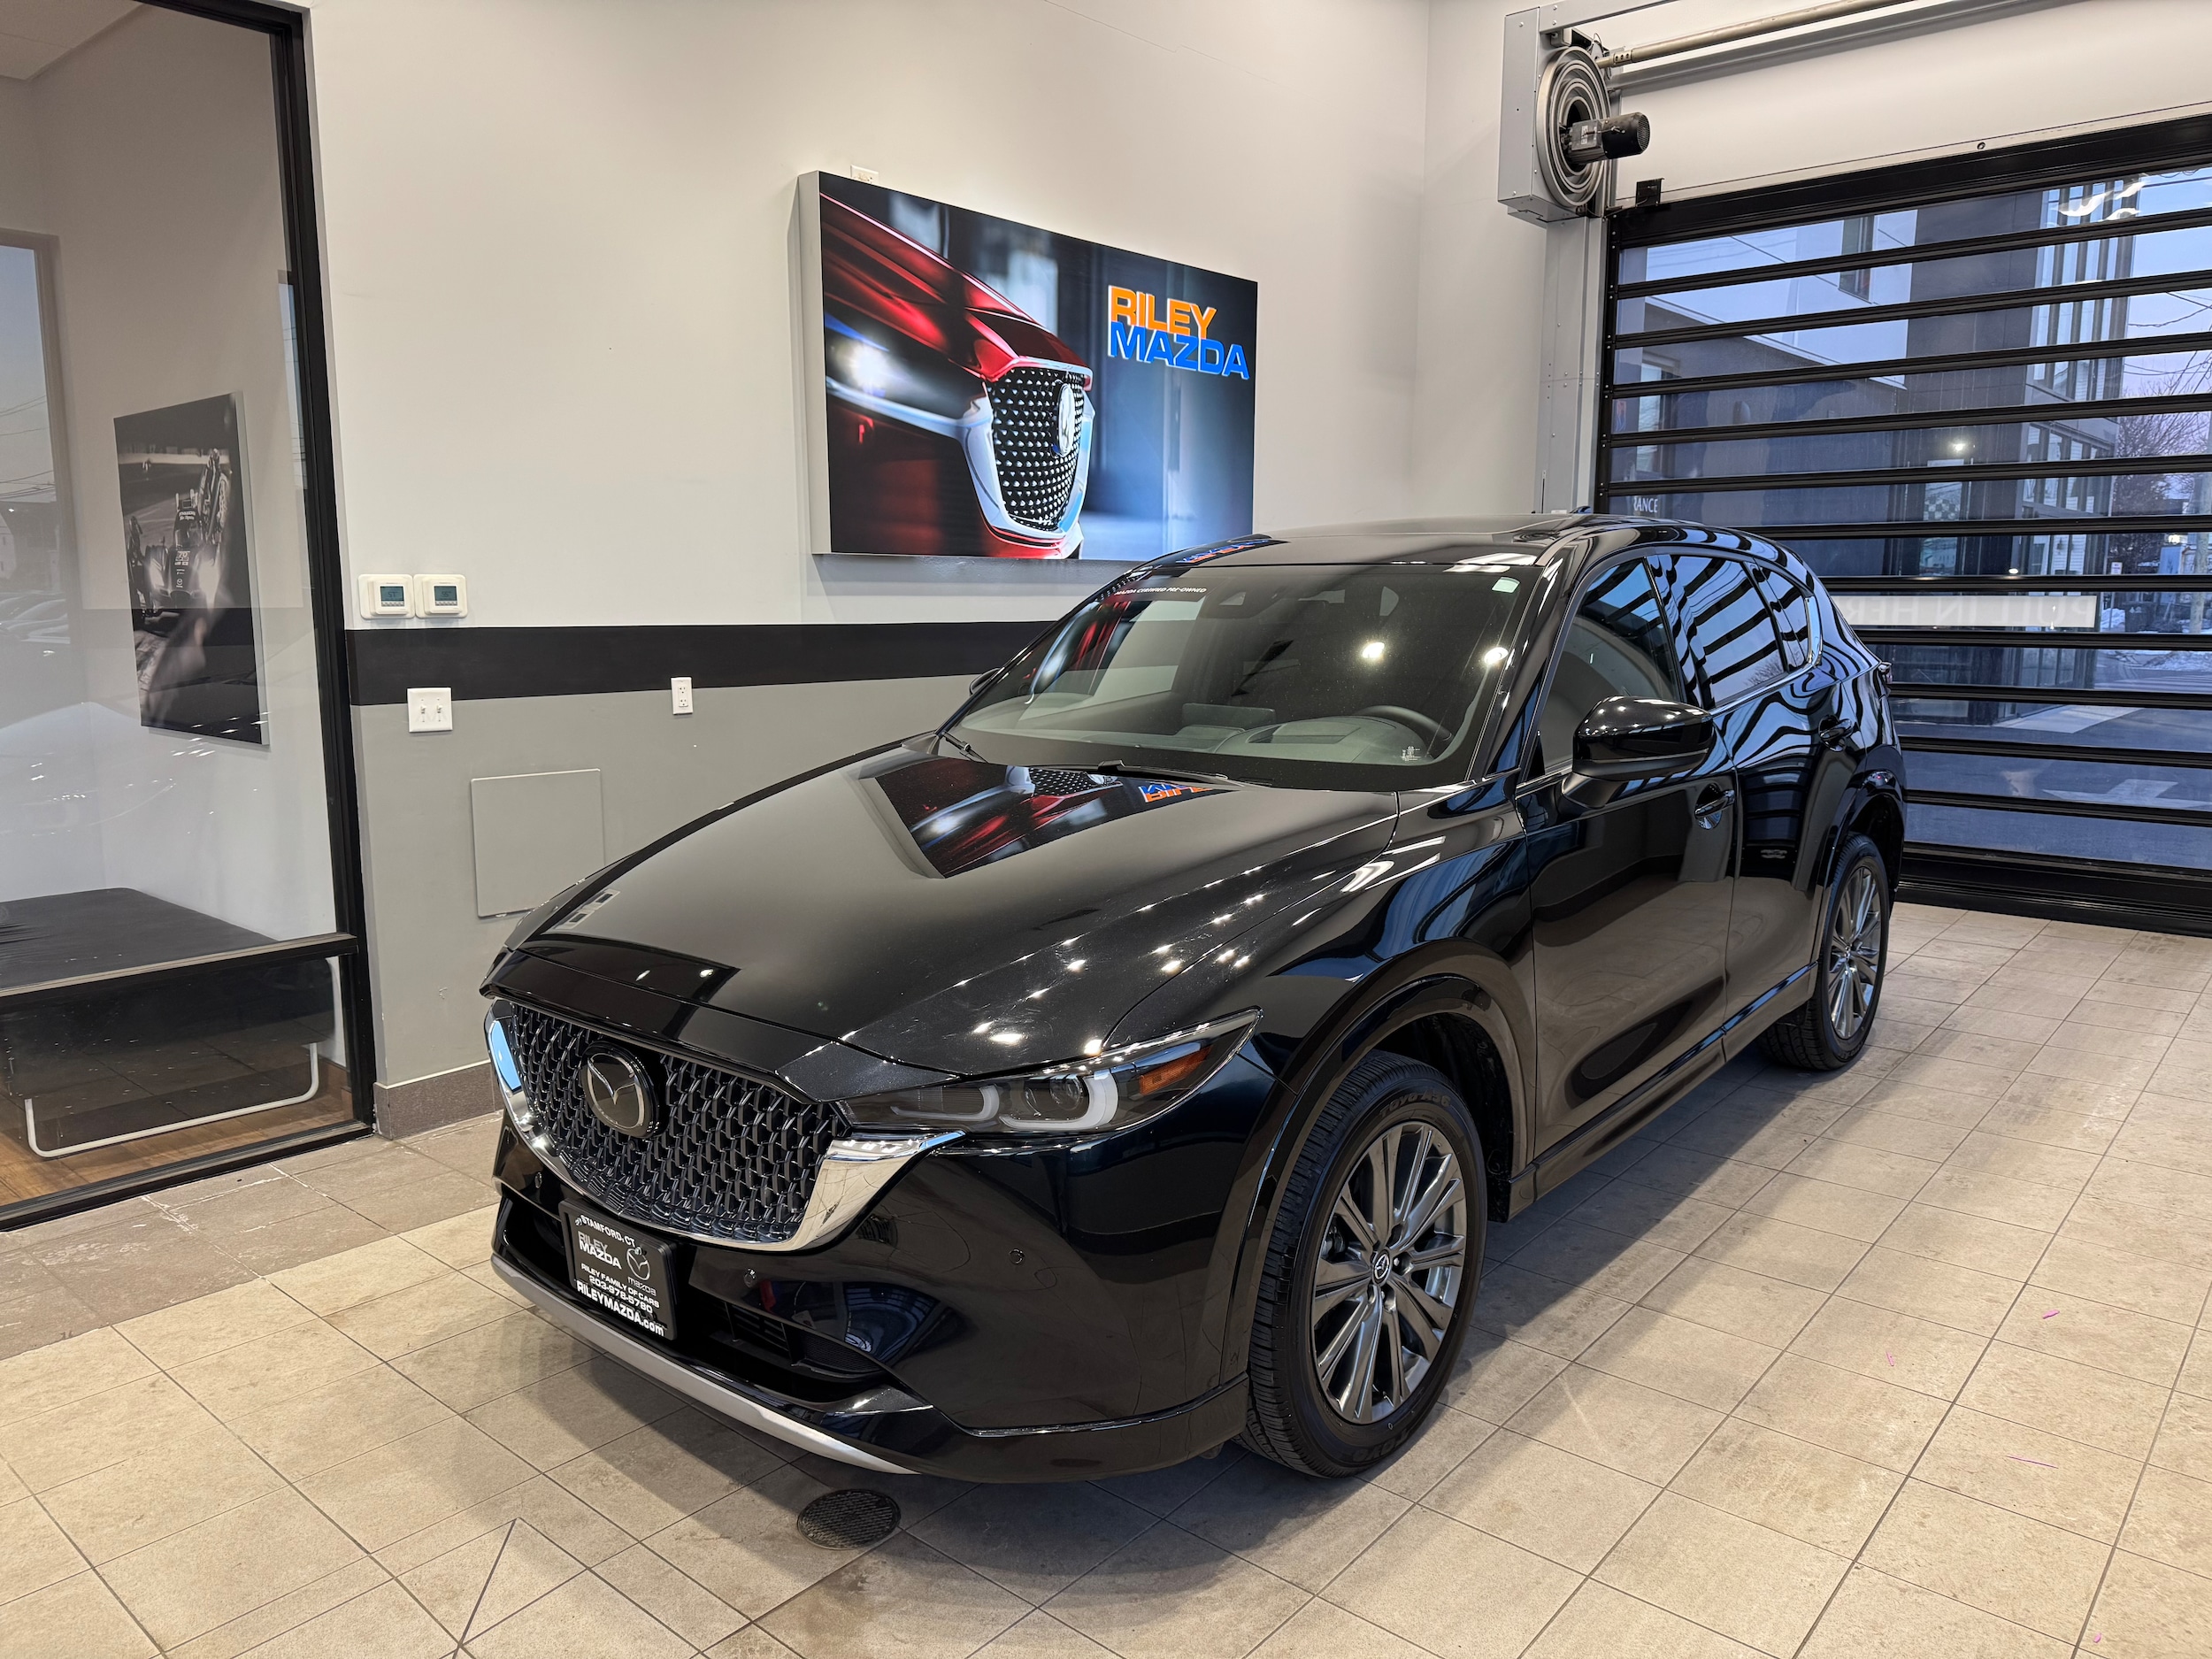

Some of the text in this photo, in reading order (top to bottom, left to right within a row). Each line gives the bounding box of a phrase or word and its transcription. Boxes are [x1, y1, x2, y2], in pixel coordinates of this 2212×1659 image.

[1108, 285, 1217, 340] RILEY
[1108, 321, 1249, 380] MAZDA
[578, 1231, 608, 1253] RILEY
[579, 1240, 622, 1270] MAZDA
[625, 1235, 636, 1248] CT
[580, 1263, 660, 1308] RILEY FAMILY OF CARS
[588, 1275, 653, 1314] 203-978-5780
[577, 1280, 664, 1337] RILEYMAZDA.com
